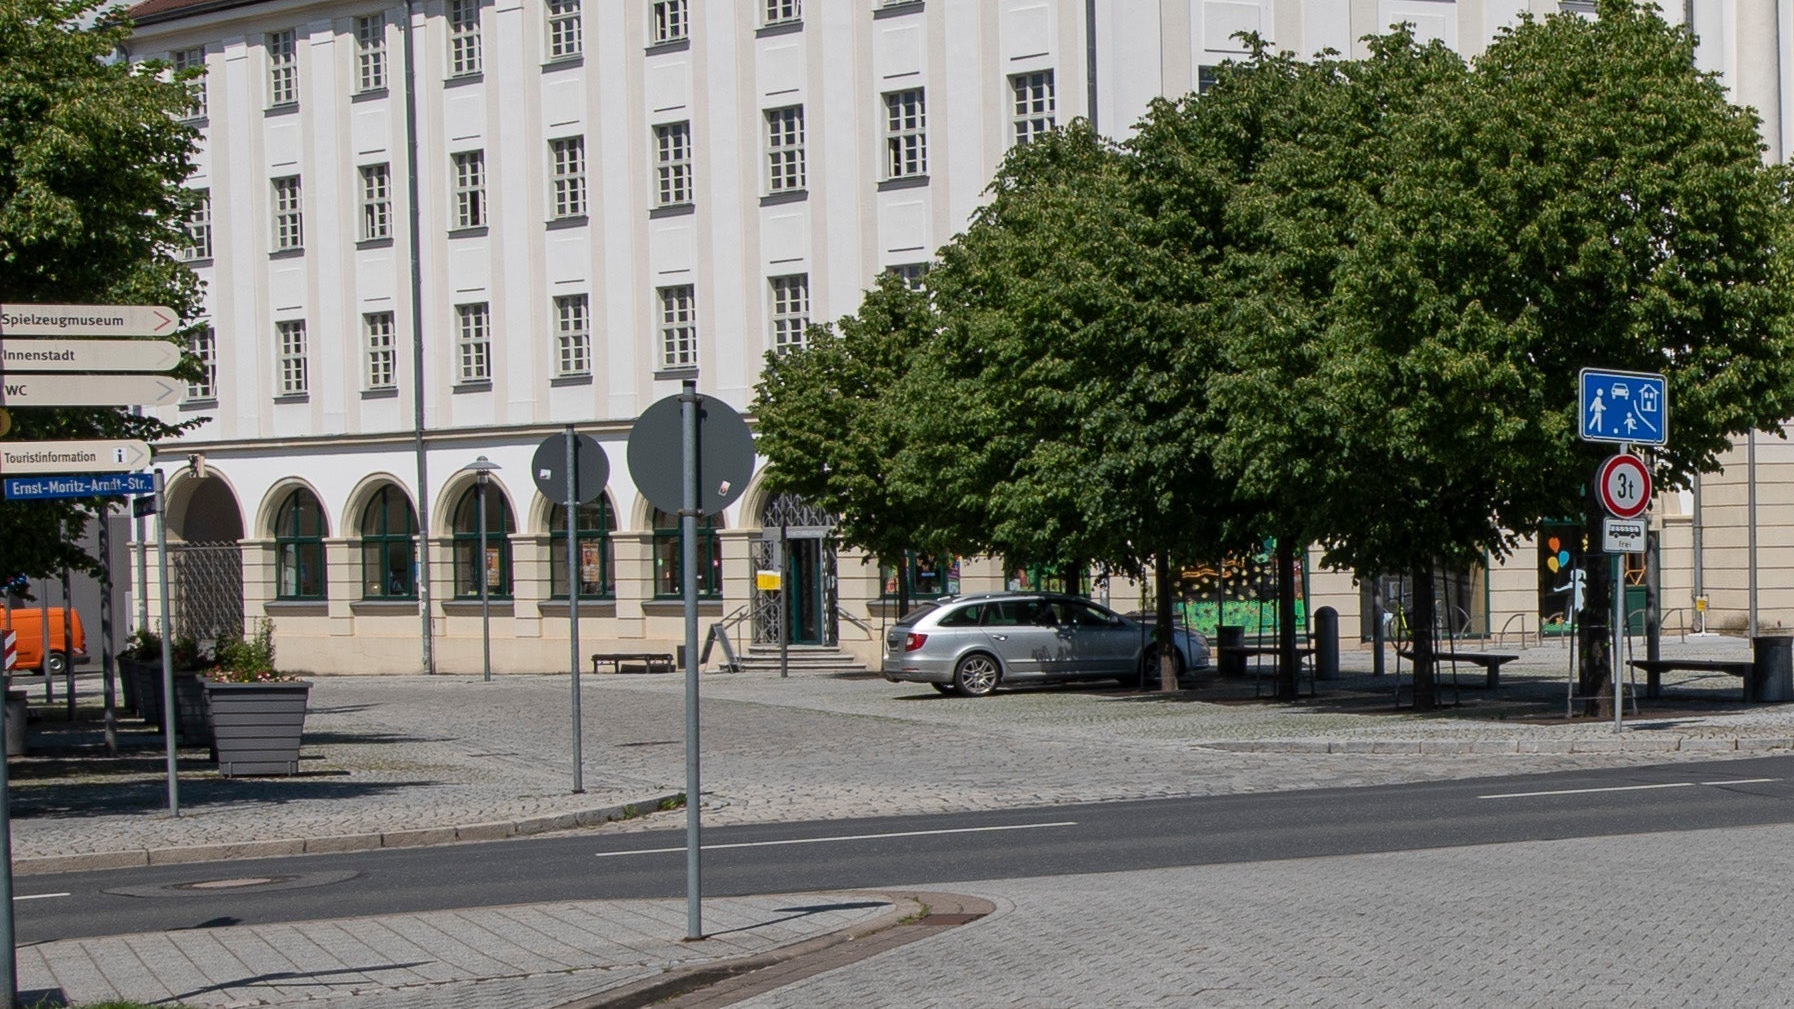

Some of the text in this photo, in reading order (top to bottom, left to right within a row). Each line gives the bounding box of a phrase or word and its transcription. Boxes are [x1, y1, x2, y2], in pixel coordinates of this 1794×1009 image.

[1, 314, 124, 327] Spielzeugmuseum
[4, 350, 75, 361] Innenstadt
[5, 385, 27, 396] WC
[5, 451, 97, 464] Touristinformation
